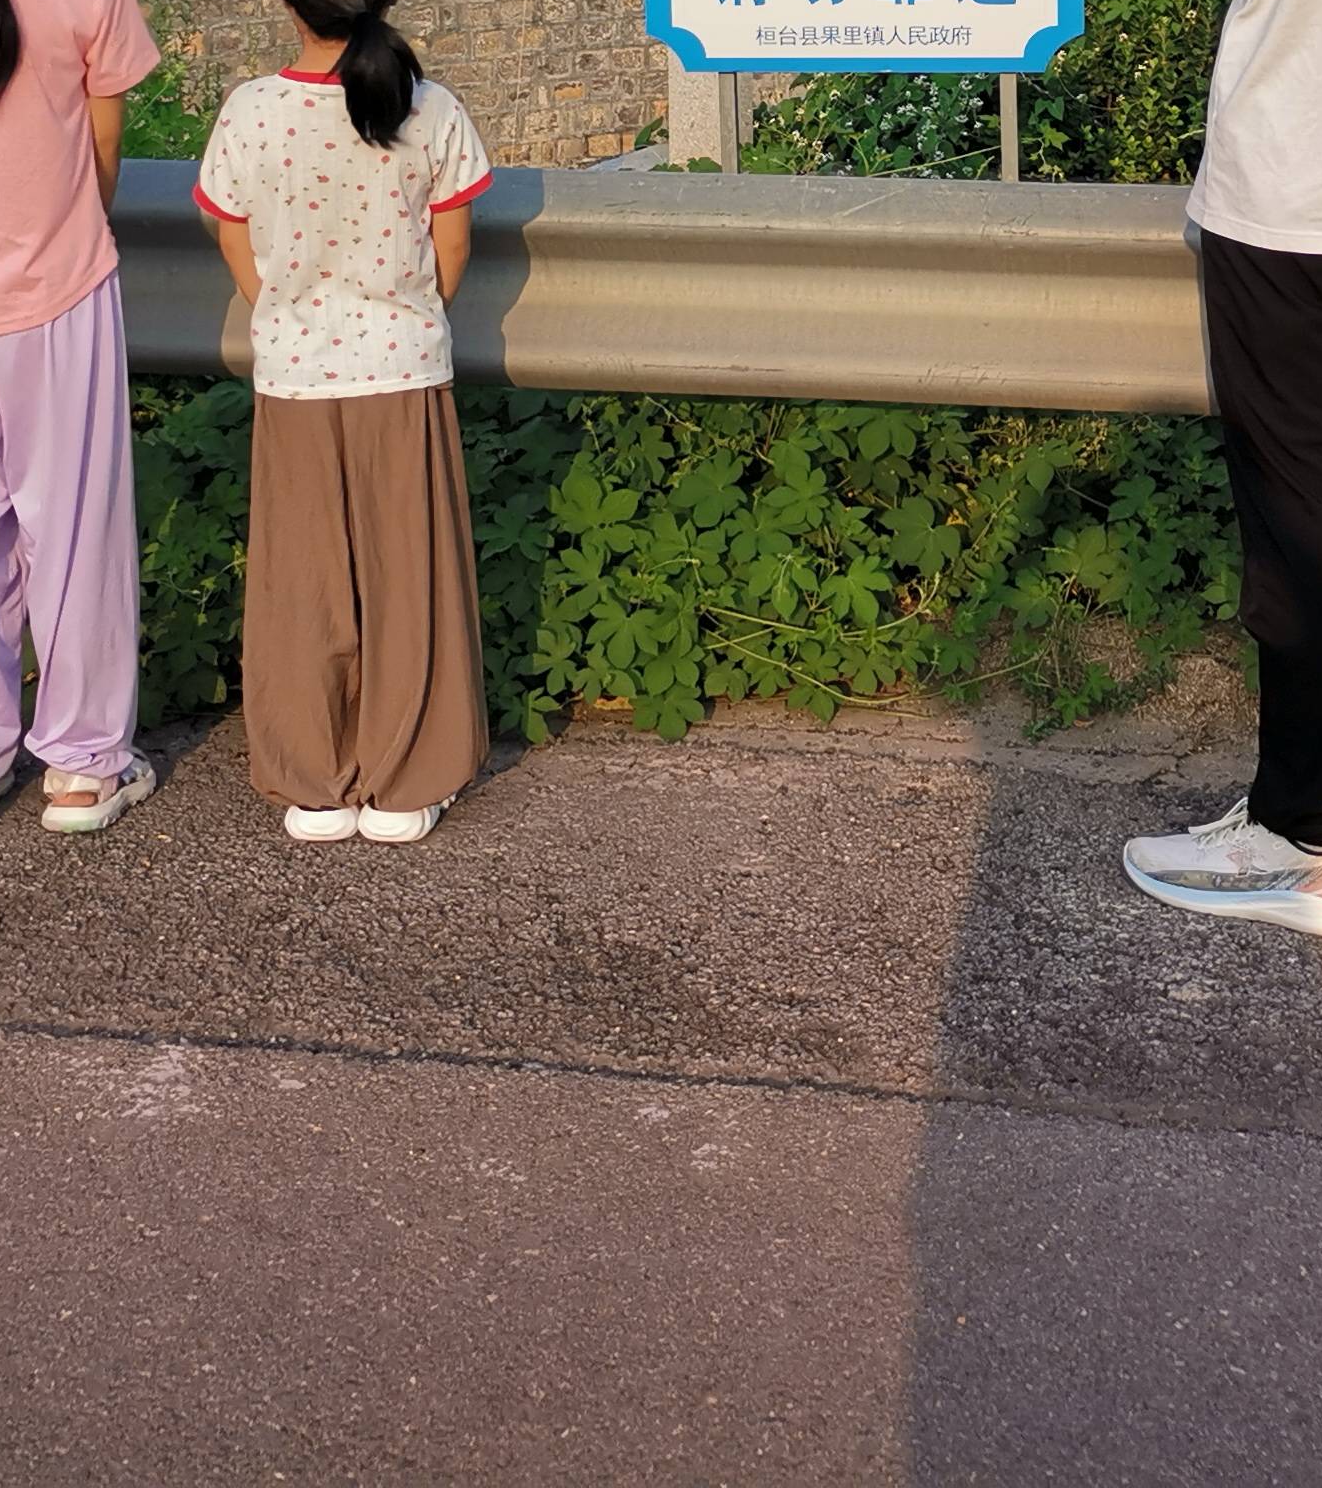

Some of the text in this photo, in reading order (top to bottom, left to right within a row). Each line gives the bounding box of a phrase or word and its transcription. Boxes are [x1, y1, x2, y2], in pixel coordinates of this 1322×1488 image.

[755, 24, 973, 48] 桓台县果里镇人民政府
